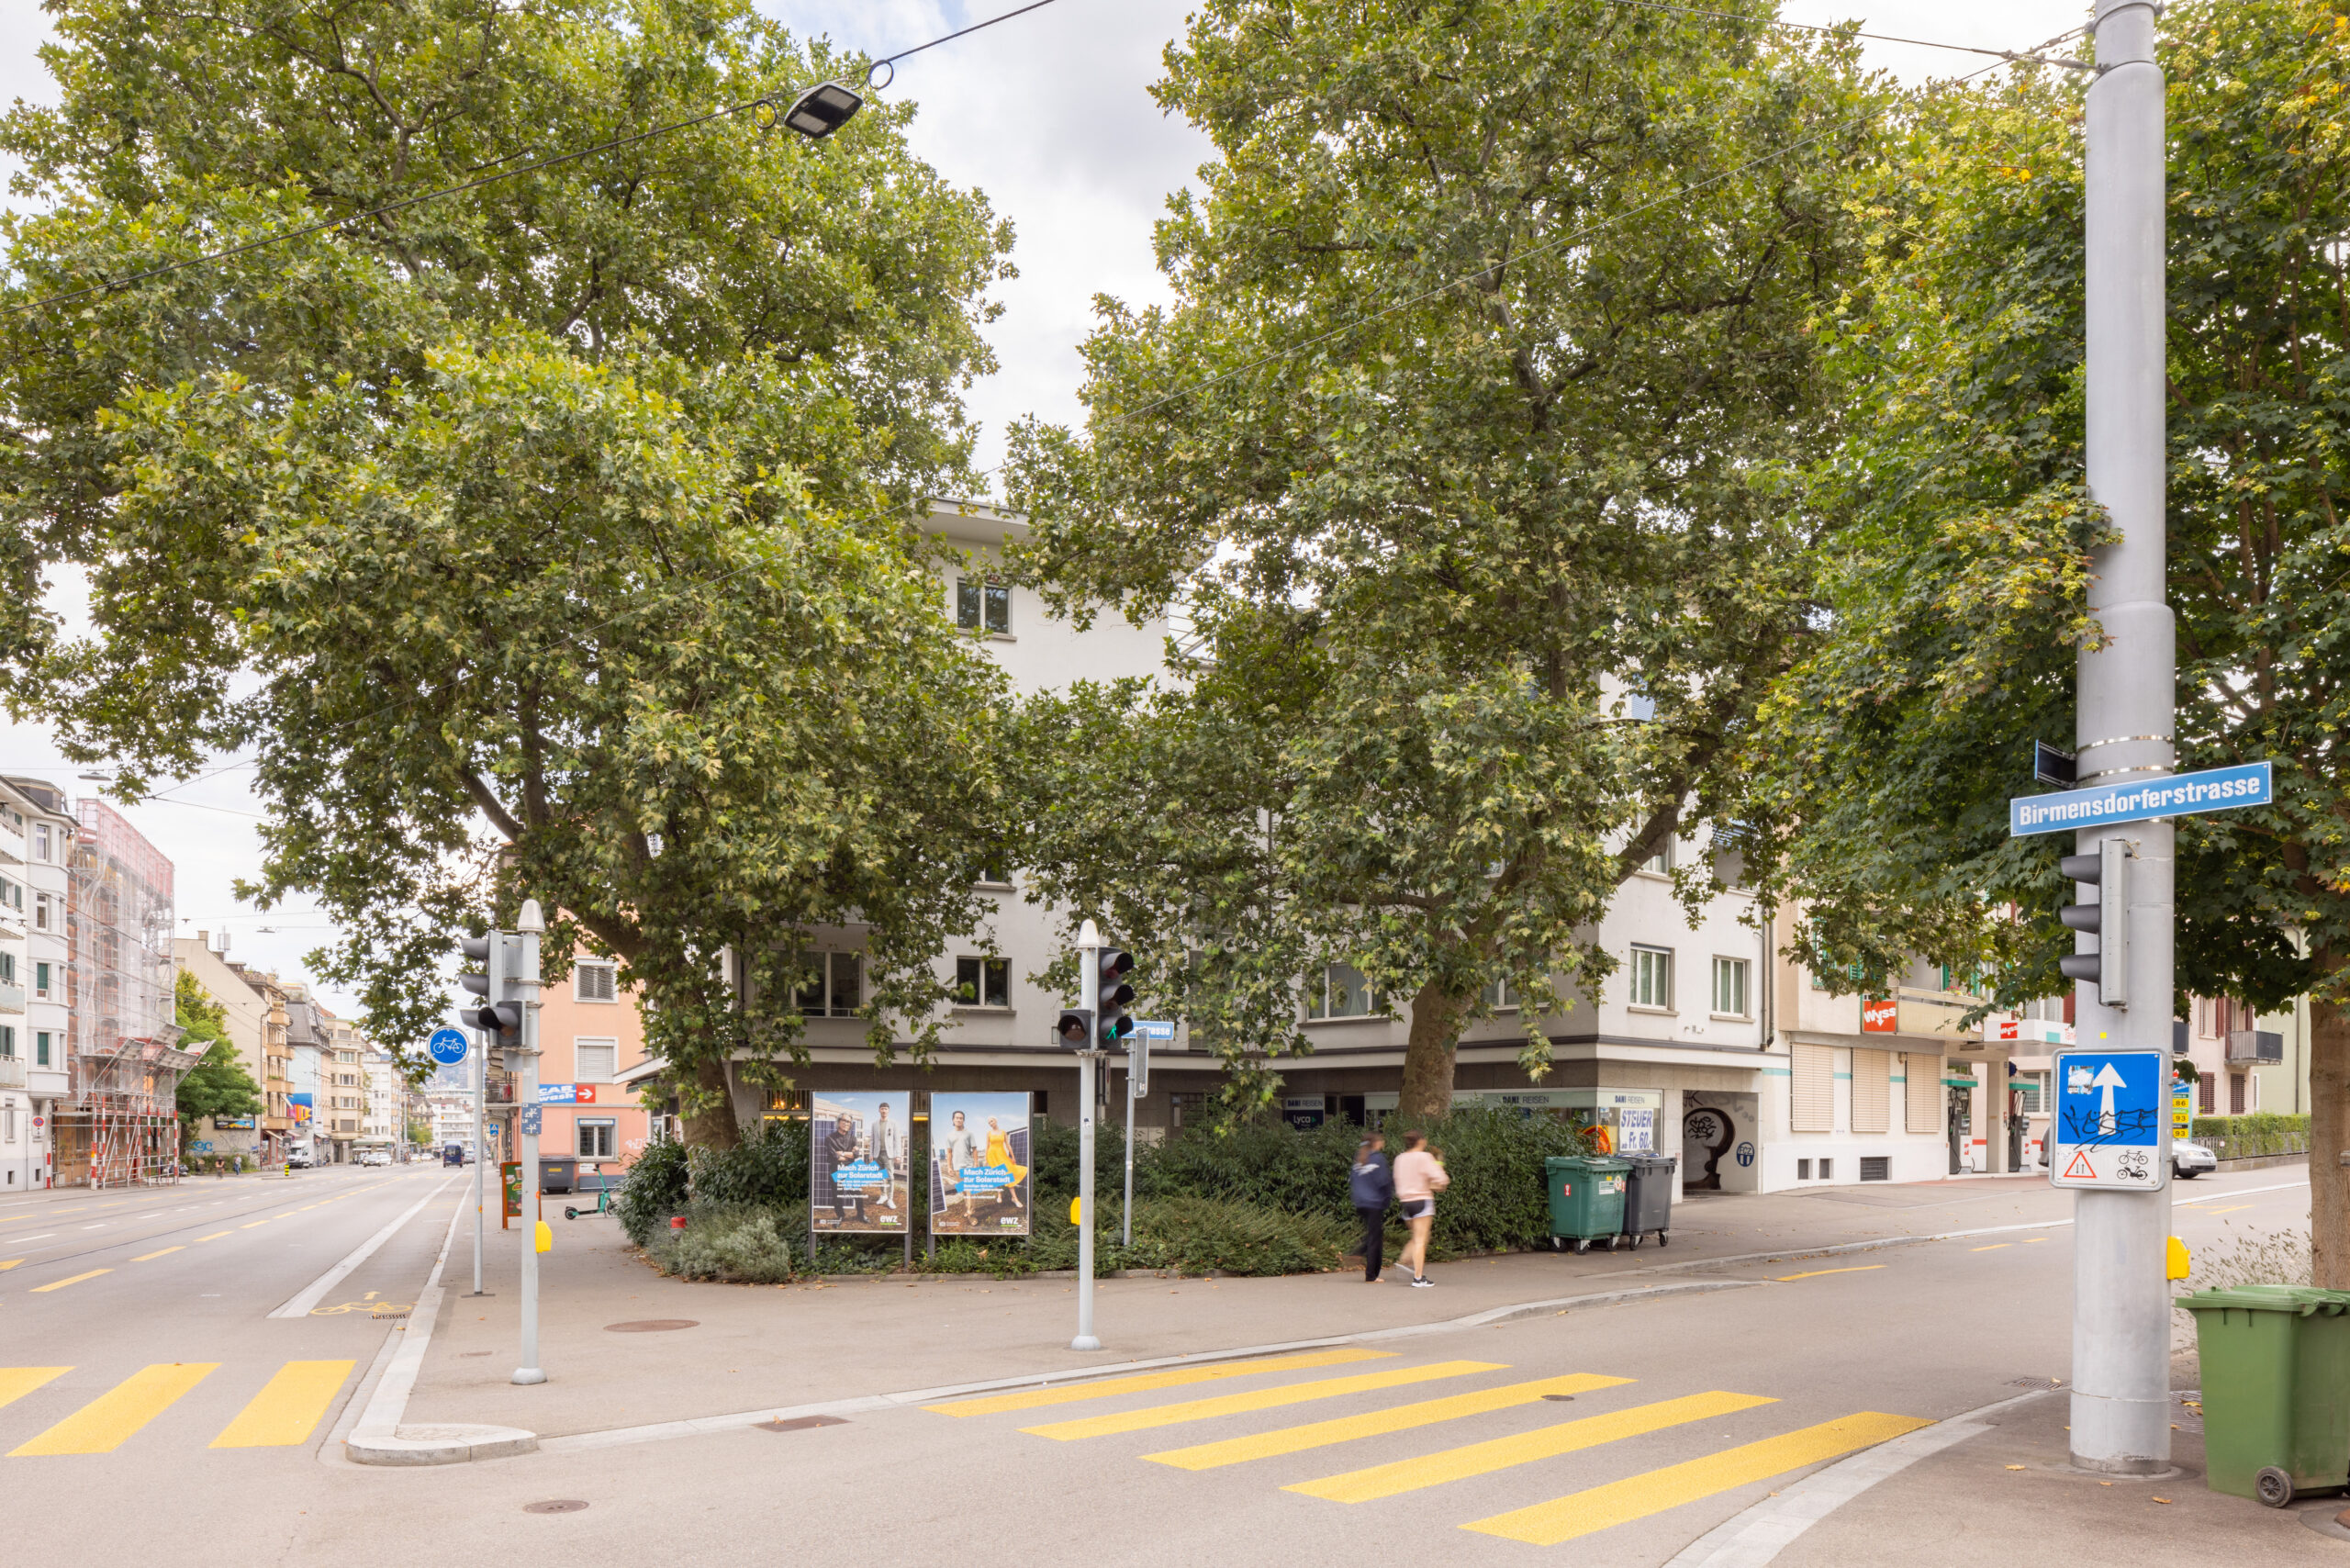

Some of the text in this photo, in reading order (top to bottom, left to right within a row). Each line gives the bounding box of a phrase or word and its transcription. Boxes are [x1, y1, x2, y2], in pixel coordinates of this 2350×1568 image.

[2020, 777, 2260, 826] Birmensdorferstrasse
[1864, 1007, 1897, 1026] Wyss
[538, 1085, 574, 1094] CAR
[1503, 1095, 1550, 1103] DANI REISEN
[1293, 1114, 1311, 1125] Lyca
[1621, 1110, 1653, 1127] STEUER
[1739, 1146, 1752, 1155] FCZ
[857, 1163, 879, 1171] Zürich
[1001, 1216, 1018, 1225] ewz
